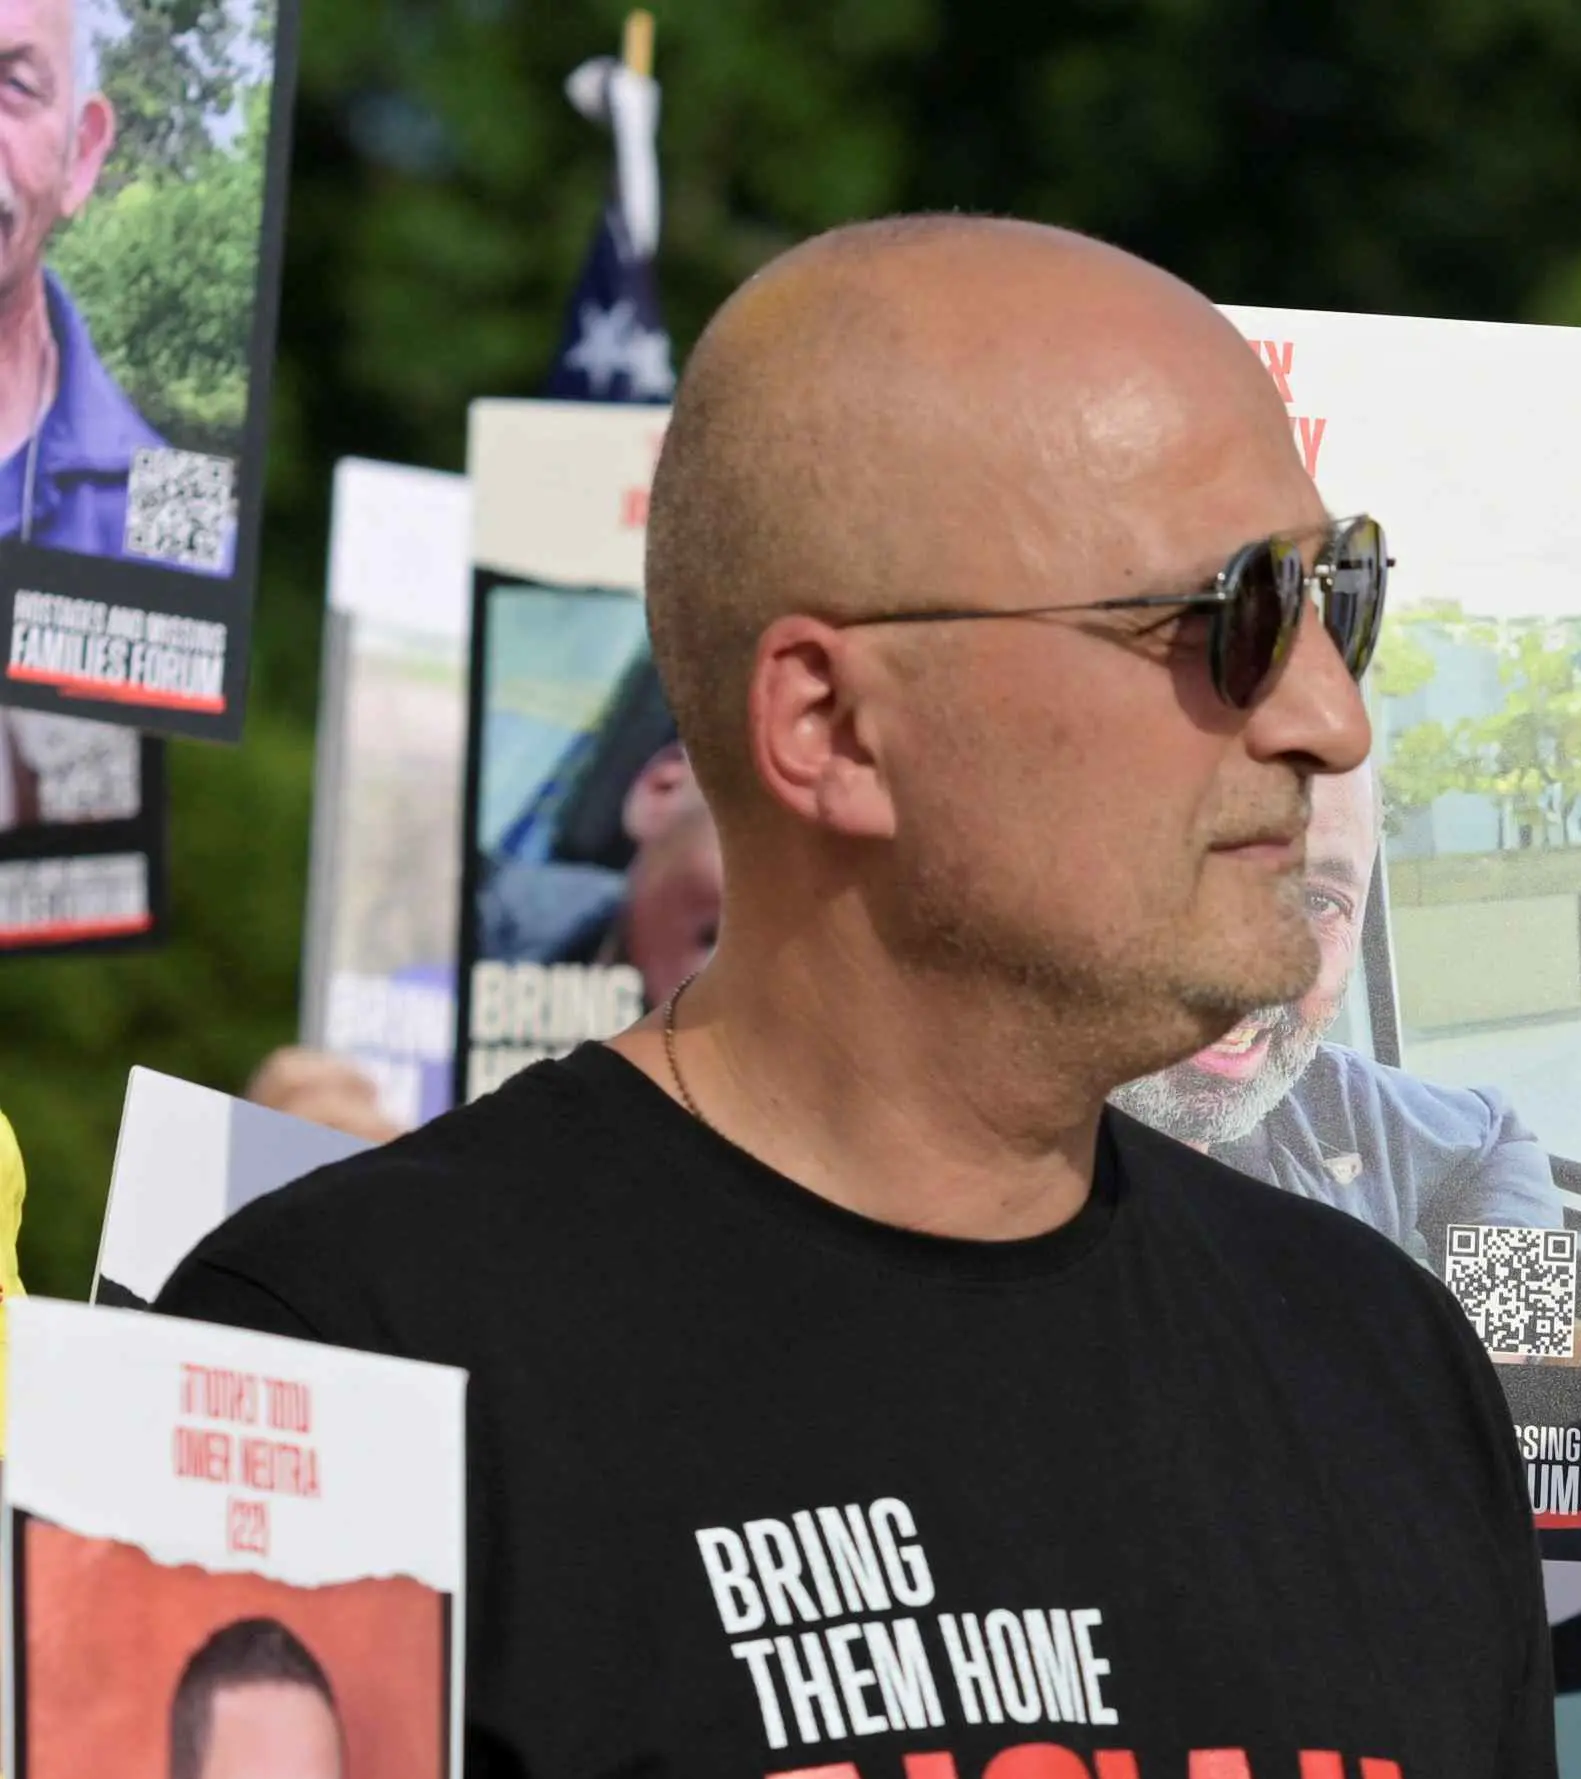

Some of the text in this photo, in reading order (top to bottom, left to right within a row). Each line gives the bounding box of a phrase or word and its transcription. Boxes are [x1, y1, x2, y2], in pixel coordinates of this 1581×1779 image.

[10, 622, 225, 699] FAMILIES FORUM
[175, 1425, 320, 1498] OMER NEUTRA
[695, 1498, 936, 1634] BRING
[731, 1608, 1119, 1749] THEM HOME
